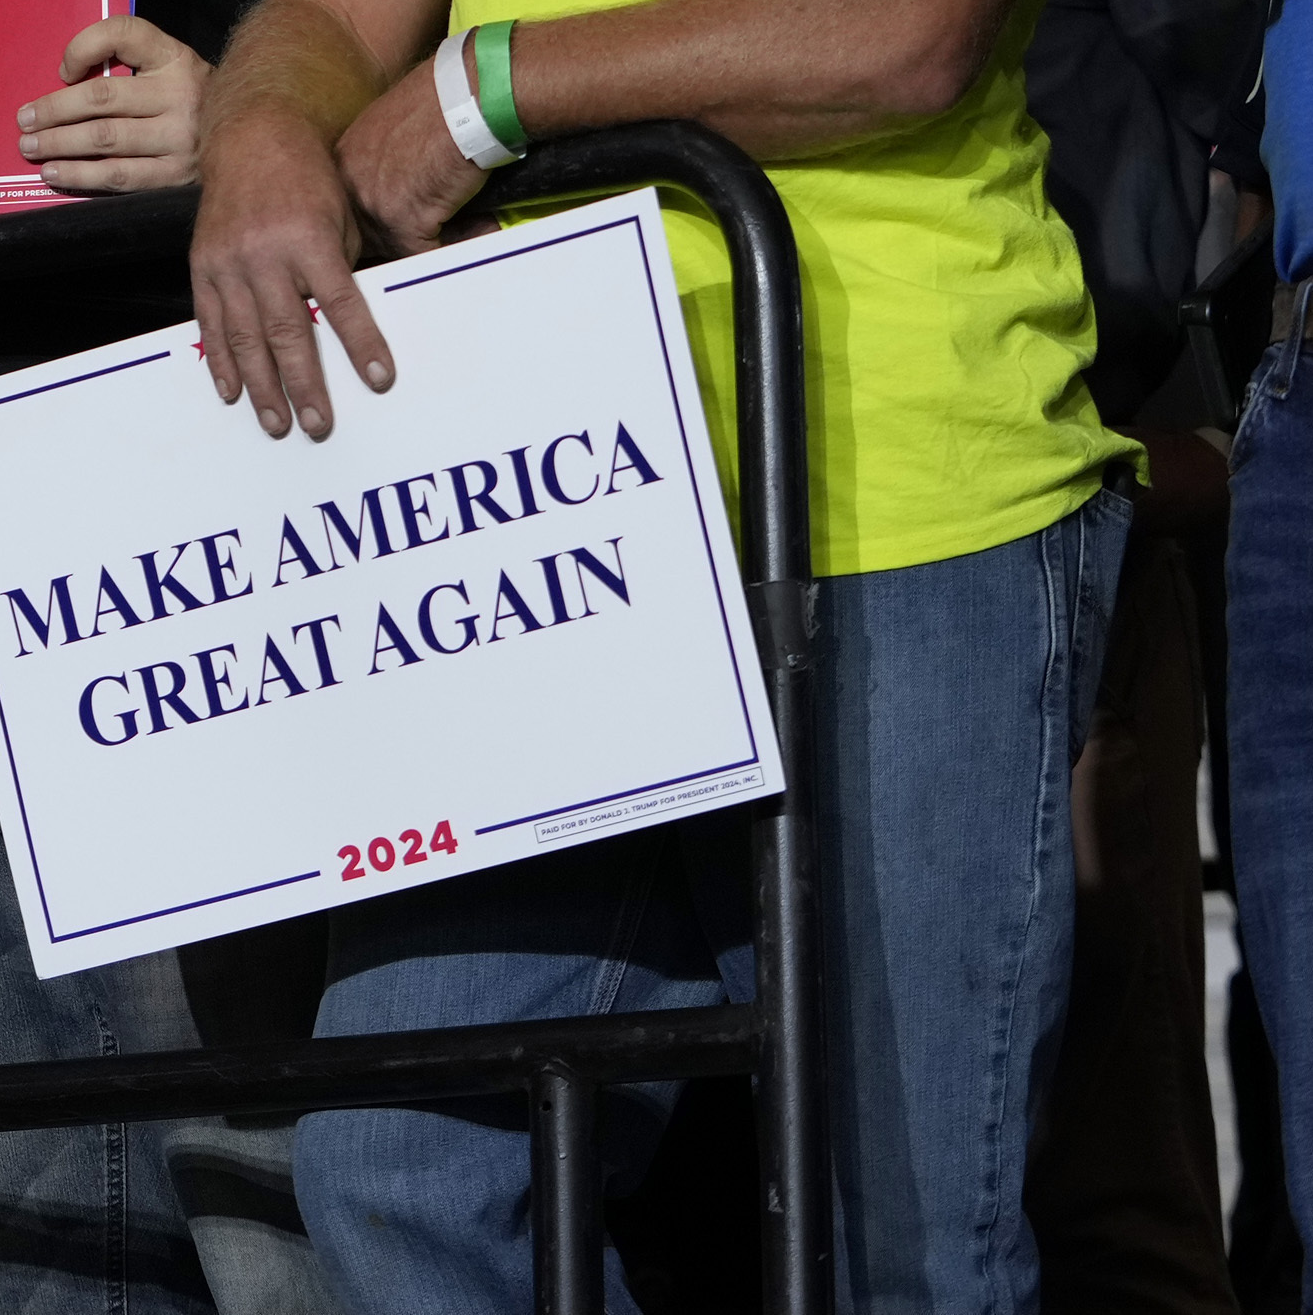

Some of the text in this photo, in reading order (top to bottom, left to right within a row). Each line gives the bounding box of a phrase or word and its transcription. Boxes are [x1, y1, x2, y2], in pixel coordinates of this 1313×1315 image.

[7, 190, 24, 198] FOR
[0, 419, 664, 658] MAKE AMERICA
[78, 536, 631, 747] GREAT AGAIN
[541, 825, 560, 836] PAID
[561, 821, 577, 830] FOR
[578, 817, 588, 827] BY
[589, 809, 623, 823] DONALD
[632, 800, 658, 812] TRUMP
[660, 795, 676, 804] FOR
[677, 784, 720, 801] PRESIDENT
[721, 779, 742, 790] 2024,
[743, 774, 759, 784] INC.
[337, 820, 459, 882] 2024
